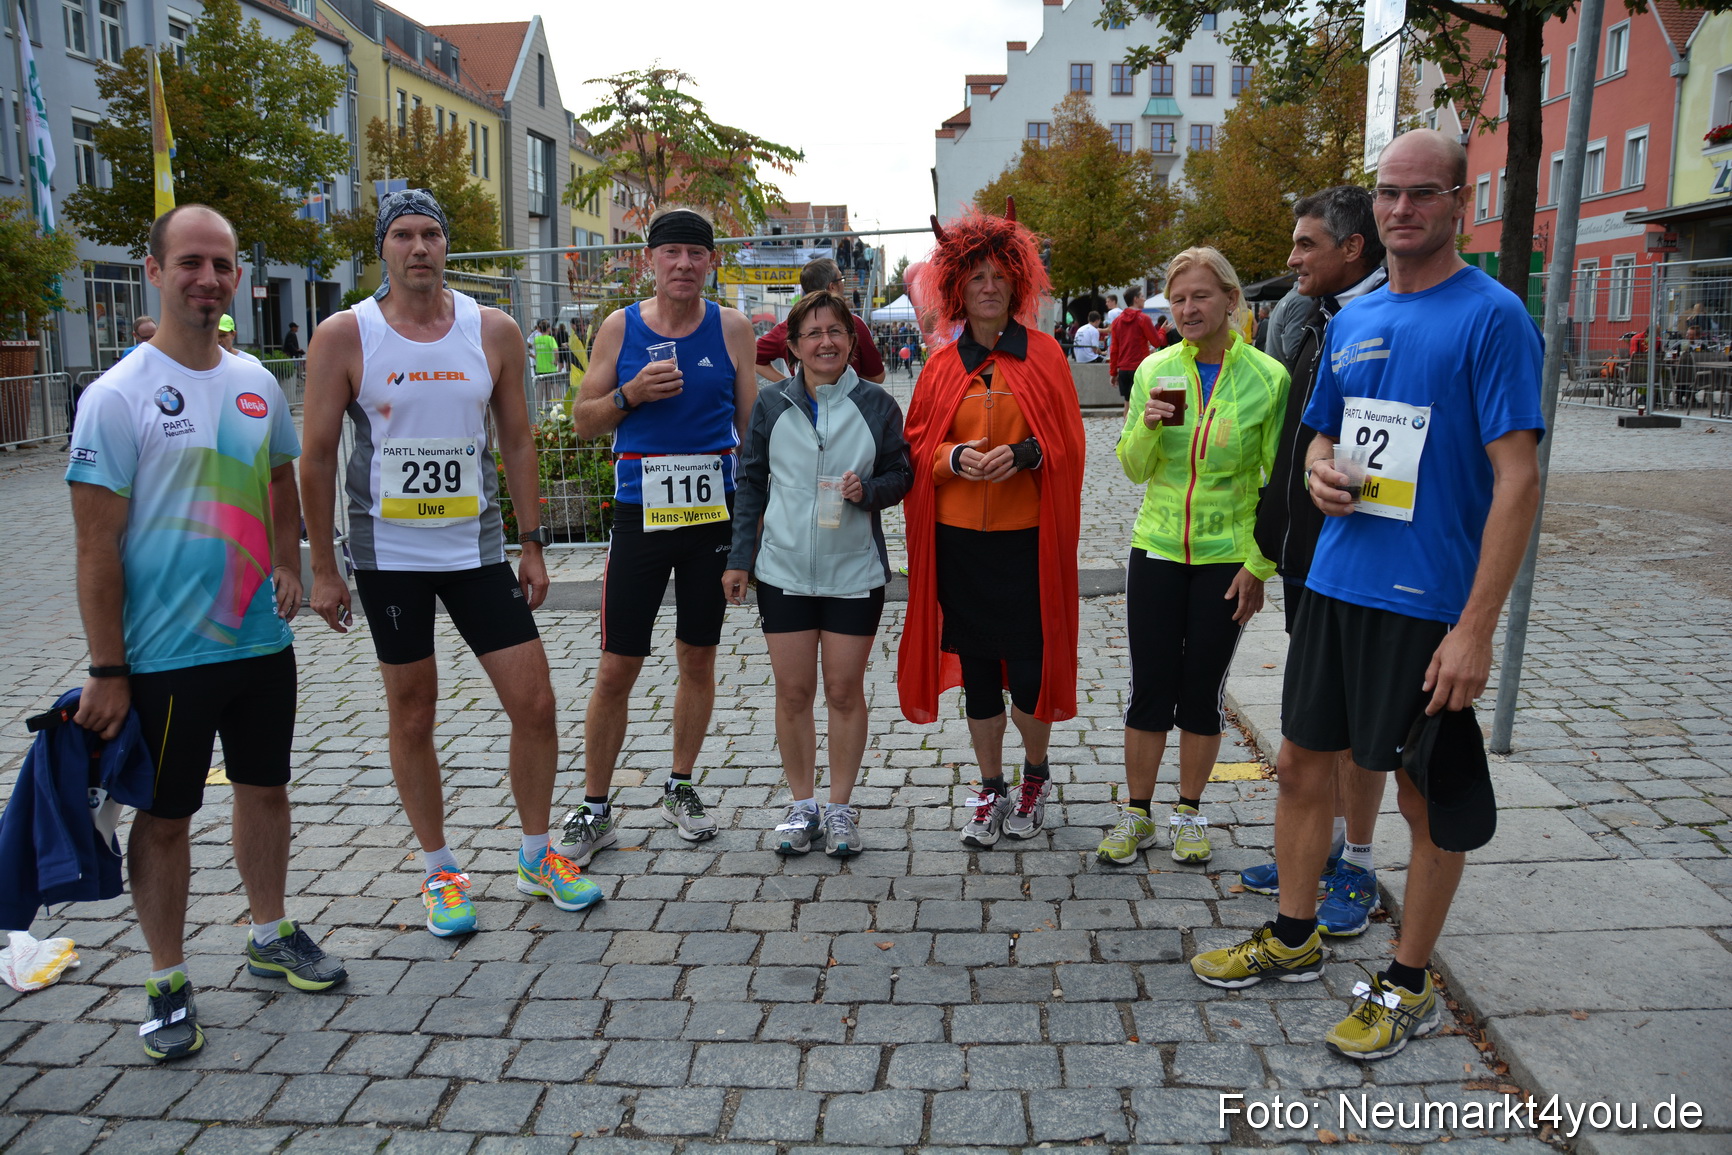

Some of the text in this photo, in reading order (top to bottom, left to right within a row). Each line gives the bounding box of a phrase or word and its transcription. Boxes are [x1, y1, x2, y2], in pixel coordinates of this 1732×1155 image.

[754, 270, 794, 280] START
[409, 371, 470, 382] KLEBL
[240, 398, 266, 412] Hervis
[1345, 408, 1408, 425] PARTL Neumarkt
[162, 419, 194, 431] PARTL
[165, 427, 196, 438] Neumarkt
[383, 447, 463, 456] PARTL Neumarkt
[674, 463, 711, 472] Neumarkt
[401, 460, 461, 494] 239
[661, 474, 712, 504] 116
[418, 503, 445, 515] Uwe
[651, 511, 722, 523] Hans-Werner
